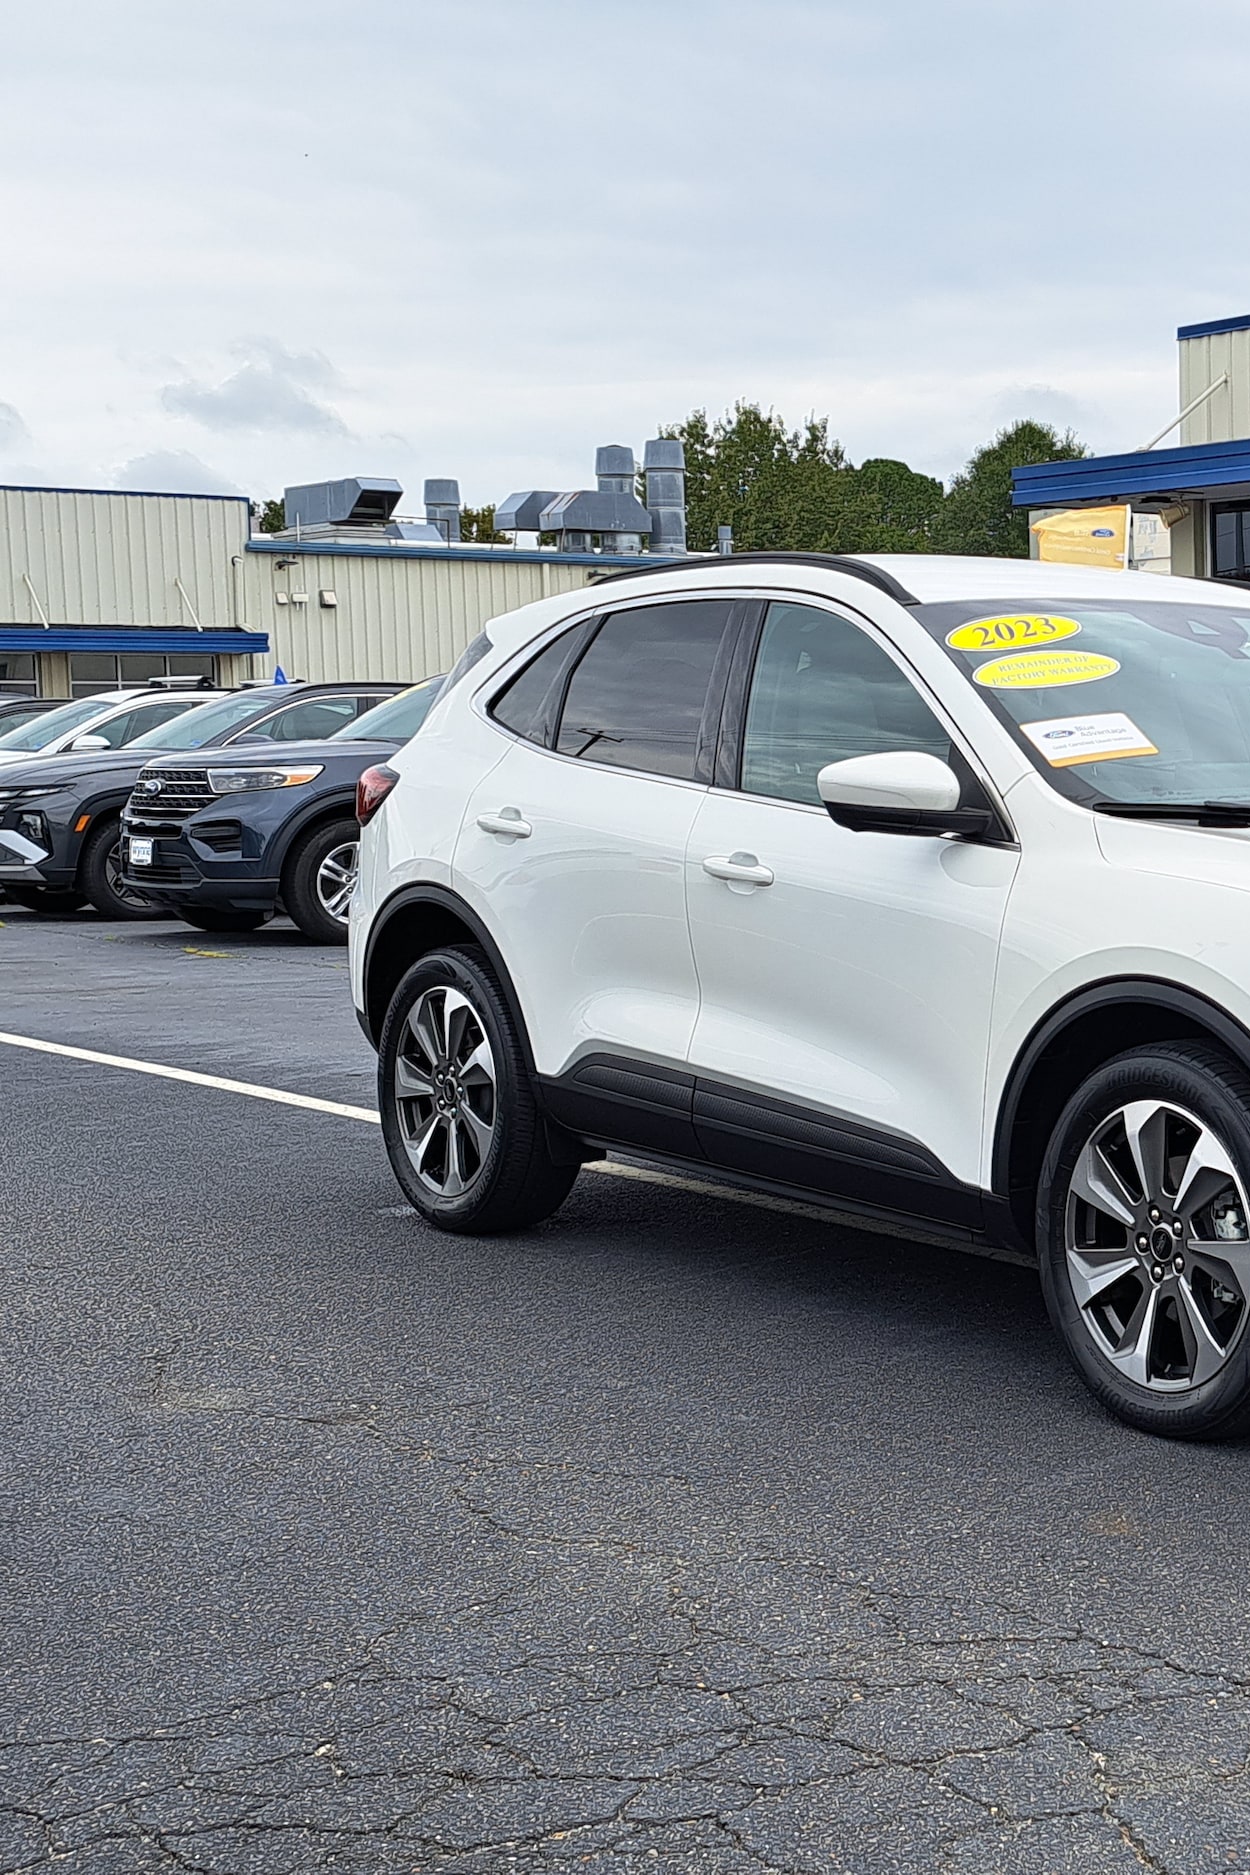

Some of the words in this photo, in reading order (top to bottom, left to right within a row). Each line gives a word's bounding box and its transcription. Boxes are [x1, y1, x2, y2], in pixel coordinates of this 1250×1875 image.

[973, 617, 1056, 646] 2023
[992, 670, 1046, 686] FACTORY
[1050, 664, 1112, 677] WARRANTY
[998, 657, 1072, 673] REMAINDER
[1074, 655, 1089, 664] OF
[1106, 1067, 1207, 1106] BRIDGESTONE
